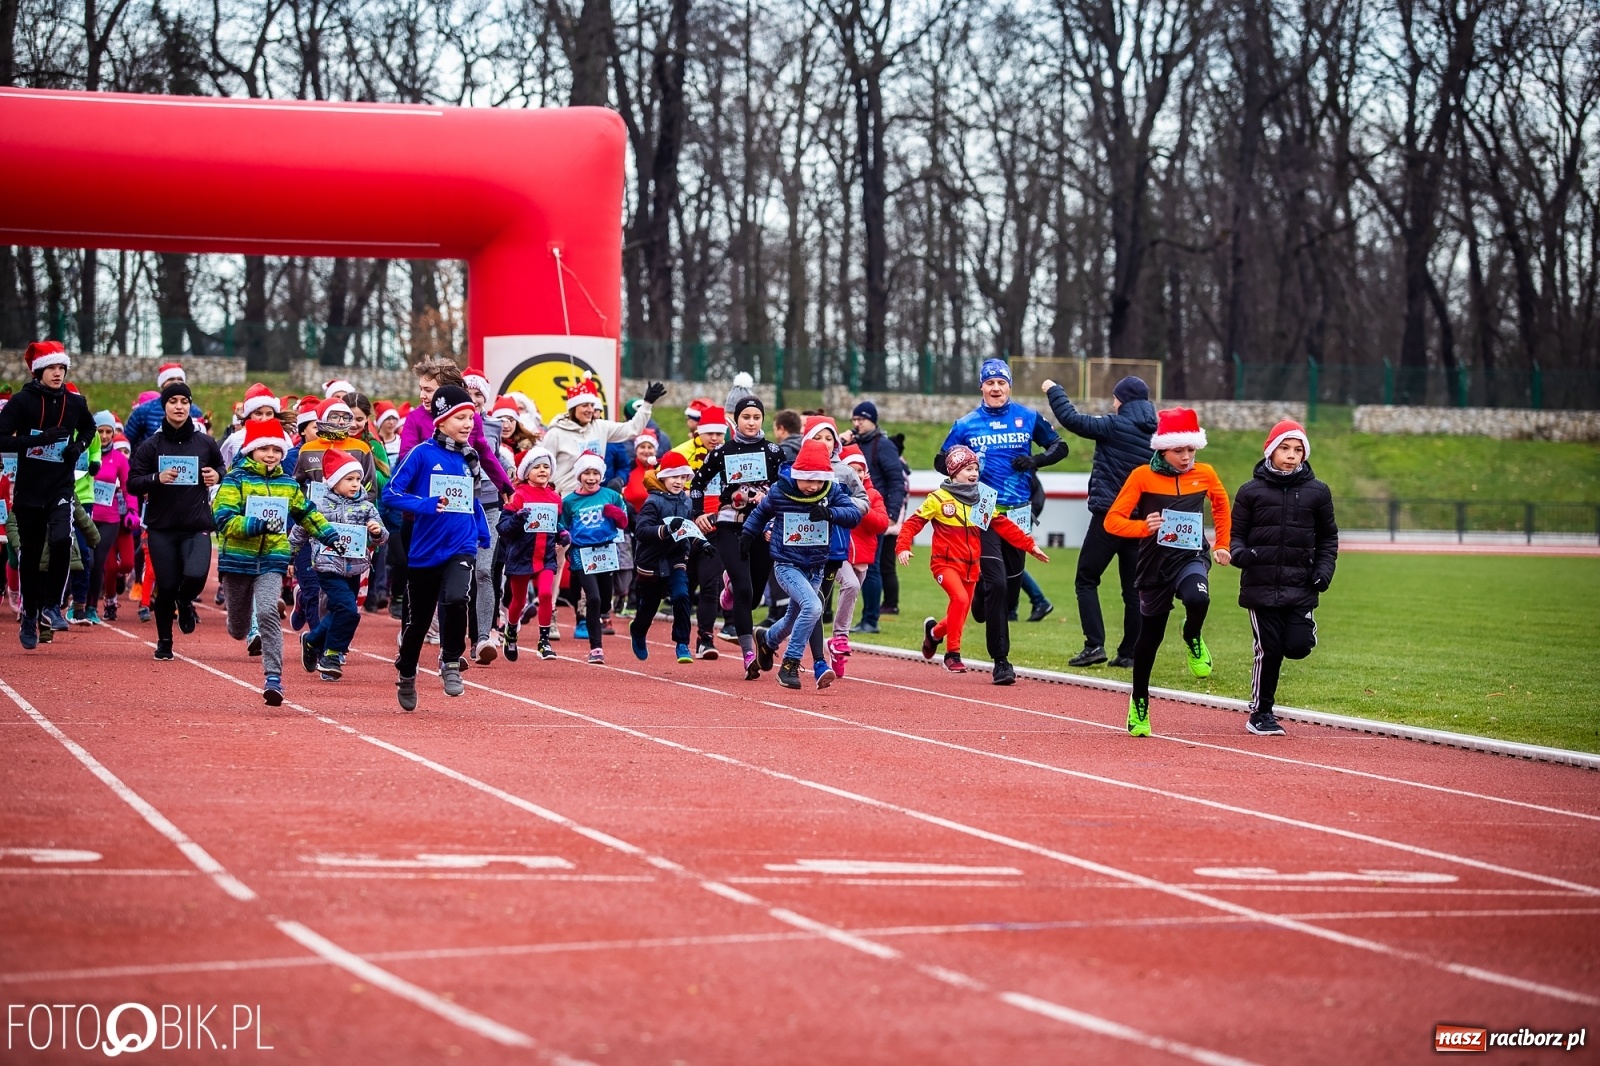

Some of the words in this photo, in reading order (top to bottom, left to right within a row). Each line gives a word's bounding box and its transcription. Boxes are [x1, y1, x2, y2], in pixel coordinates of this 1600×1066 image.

[969, 432, 1031, 448] RUNNERS
[740, 463, 753, 472] 167
[445, 487, 463, 498] 032
[979, 498, 988, 514] 056
[262, 509, 279, 519] 097
[537, 512, 550, 521] 041
[797, 524, 815, 533] 060
[1175, 523, 1193, 534] 038
